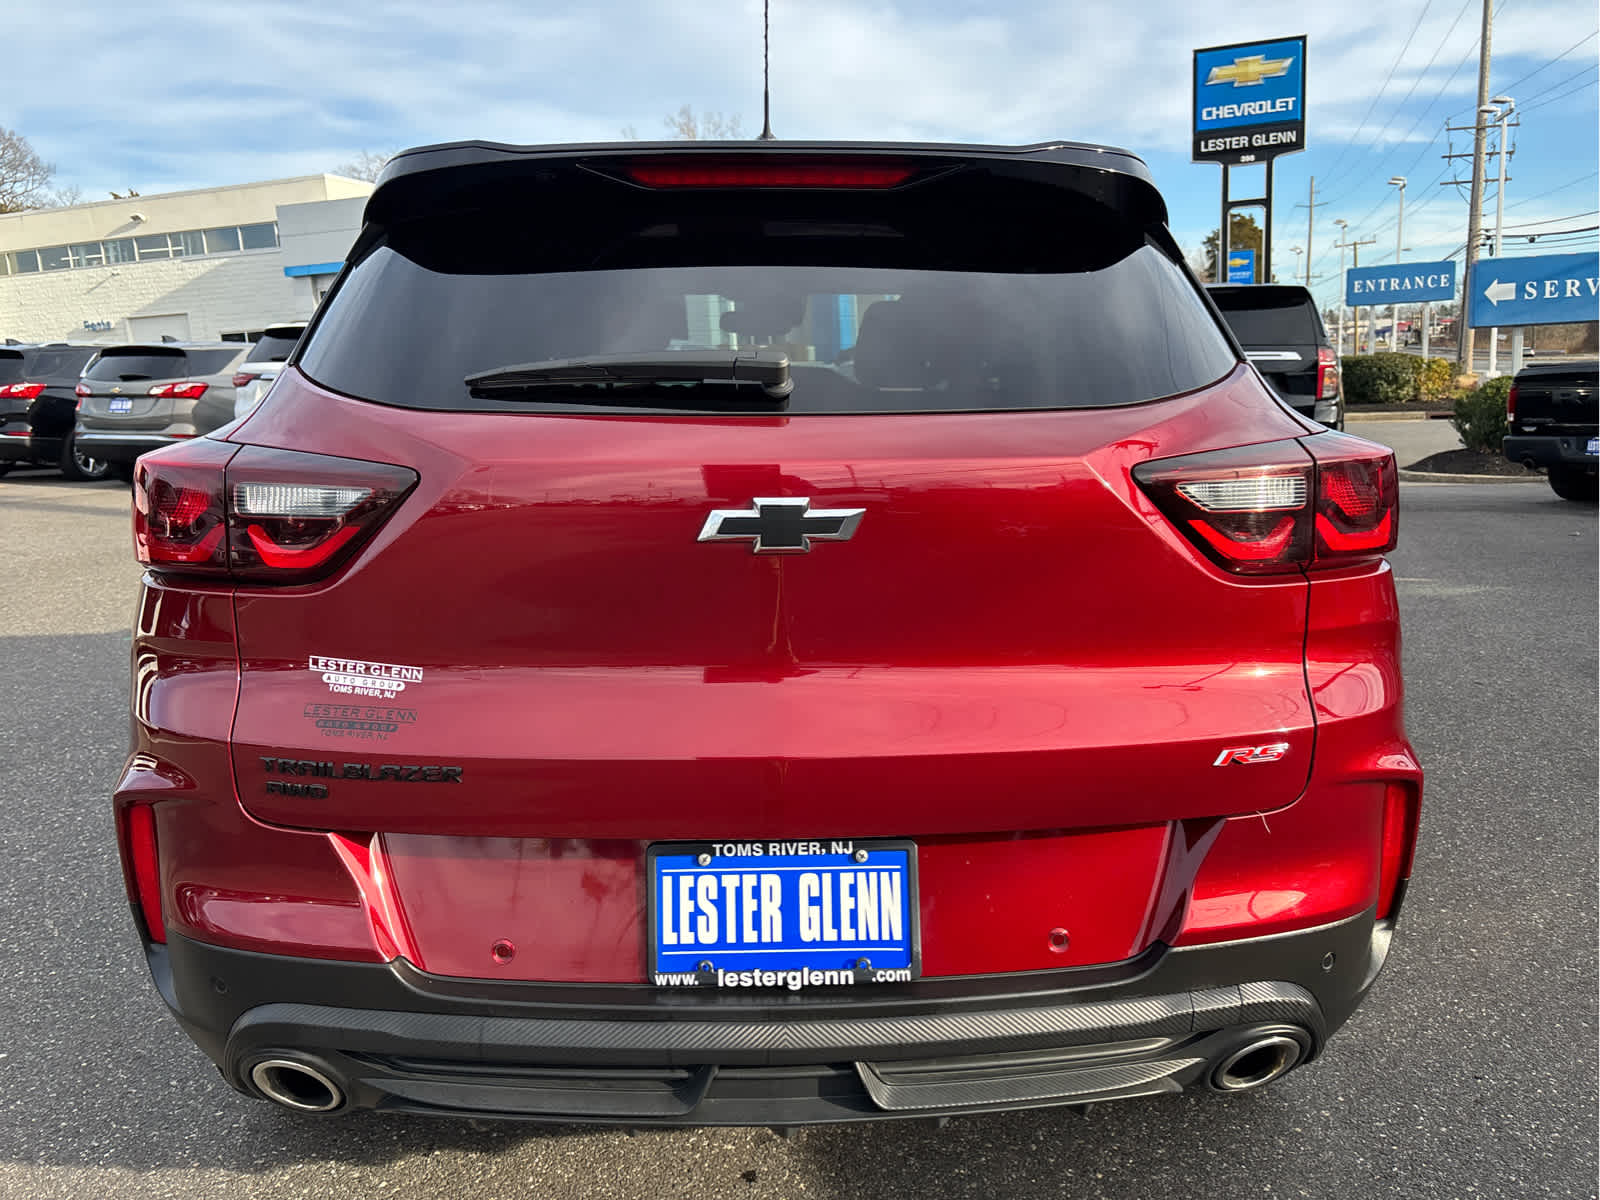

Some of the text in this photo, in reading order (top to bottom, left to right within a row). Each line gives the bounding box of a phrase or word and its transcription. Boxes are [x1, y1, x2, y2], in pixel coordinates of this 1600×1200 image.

[1201, 97, 1296, 120] CHEVROLET
[1200, 131, 1297, 152] LESTER GLENN
[1353, 273, 1450, 294] ENTRANCE
[308, 656, 423, 681] LESTER GLENN
[326, 674, 402, 689] AUTO GROUP
[328, 684, 397, 699] TOMS RIVER, NJ
[304, 704, 418, 721] LESTER GLENN
[1213, 742, 1289, 767] RS
[259, 756, 463, 784] TRAILBLAZER
[265, 780, 329, 800] AWD
[712, 841, 854, 857] TOMS RIVER, NJ
[662, 871, 903, 945] LESTER GLENN
[655, 967, 912, 990] www. lesterglenn .com
